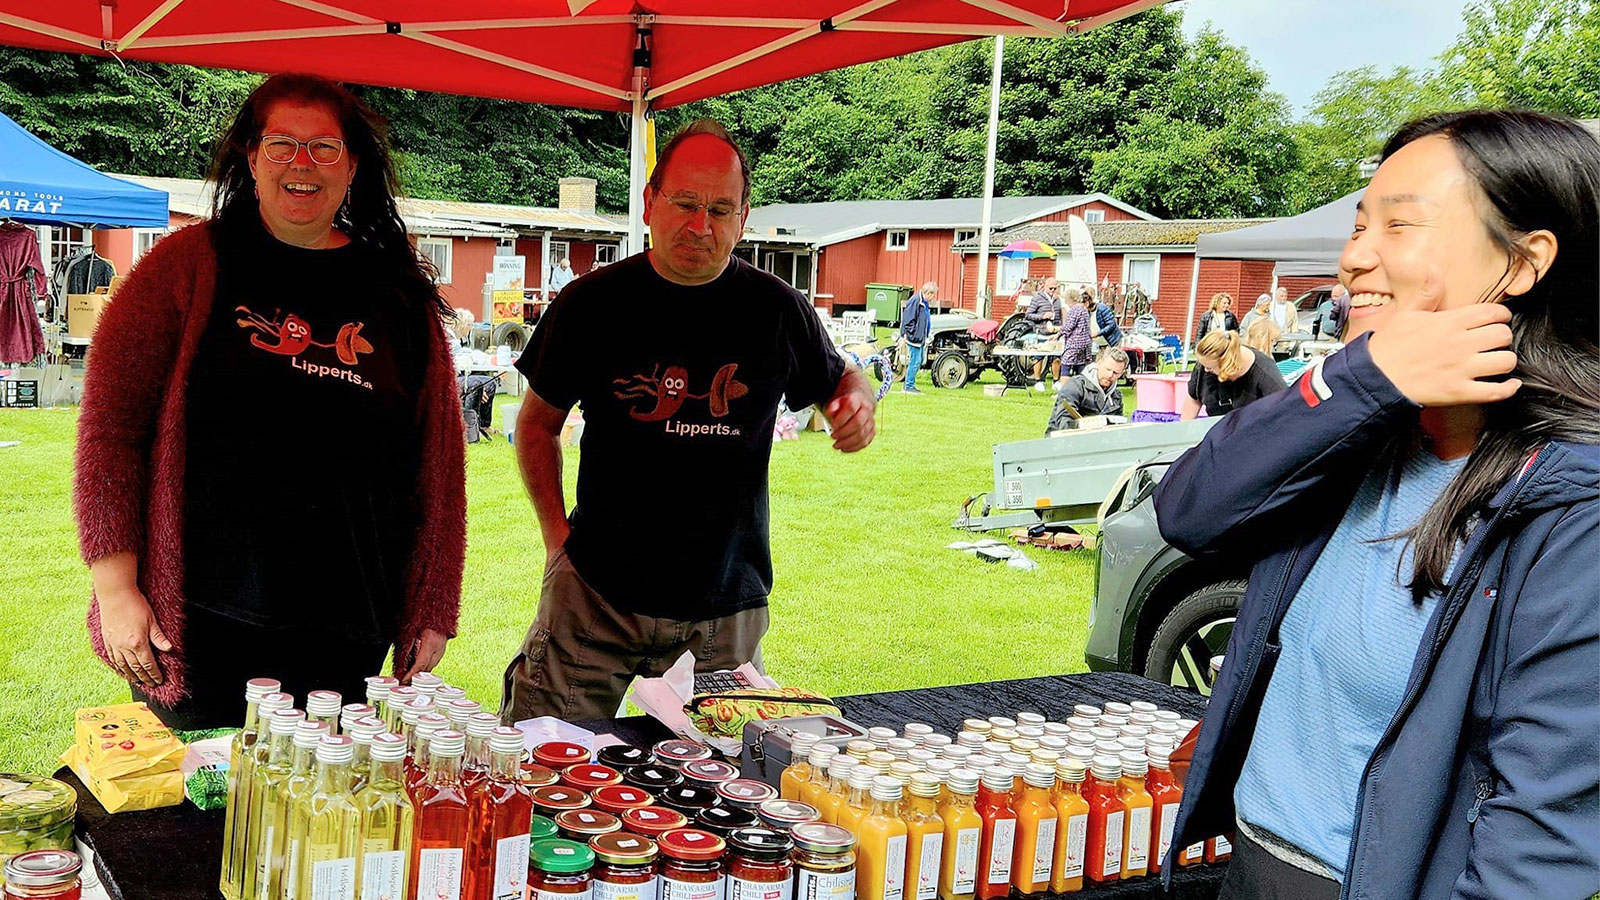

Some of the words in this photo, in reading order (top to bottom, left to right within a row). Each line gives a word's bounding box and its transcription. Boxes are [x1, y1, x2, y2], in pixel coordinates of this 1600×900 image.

[34, 192, 63, 200] TOOLS
[292, 356, 373, 390] Lipperts.dk
[665, 420, 741, 437] Lipperts.dk
[742, 890, 762, 899] CHILI
